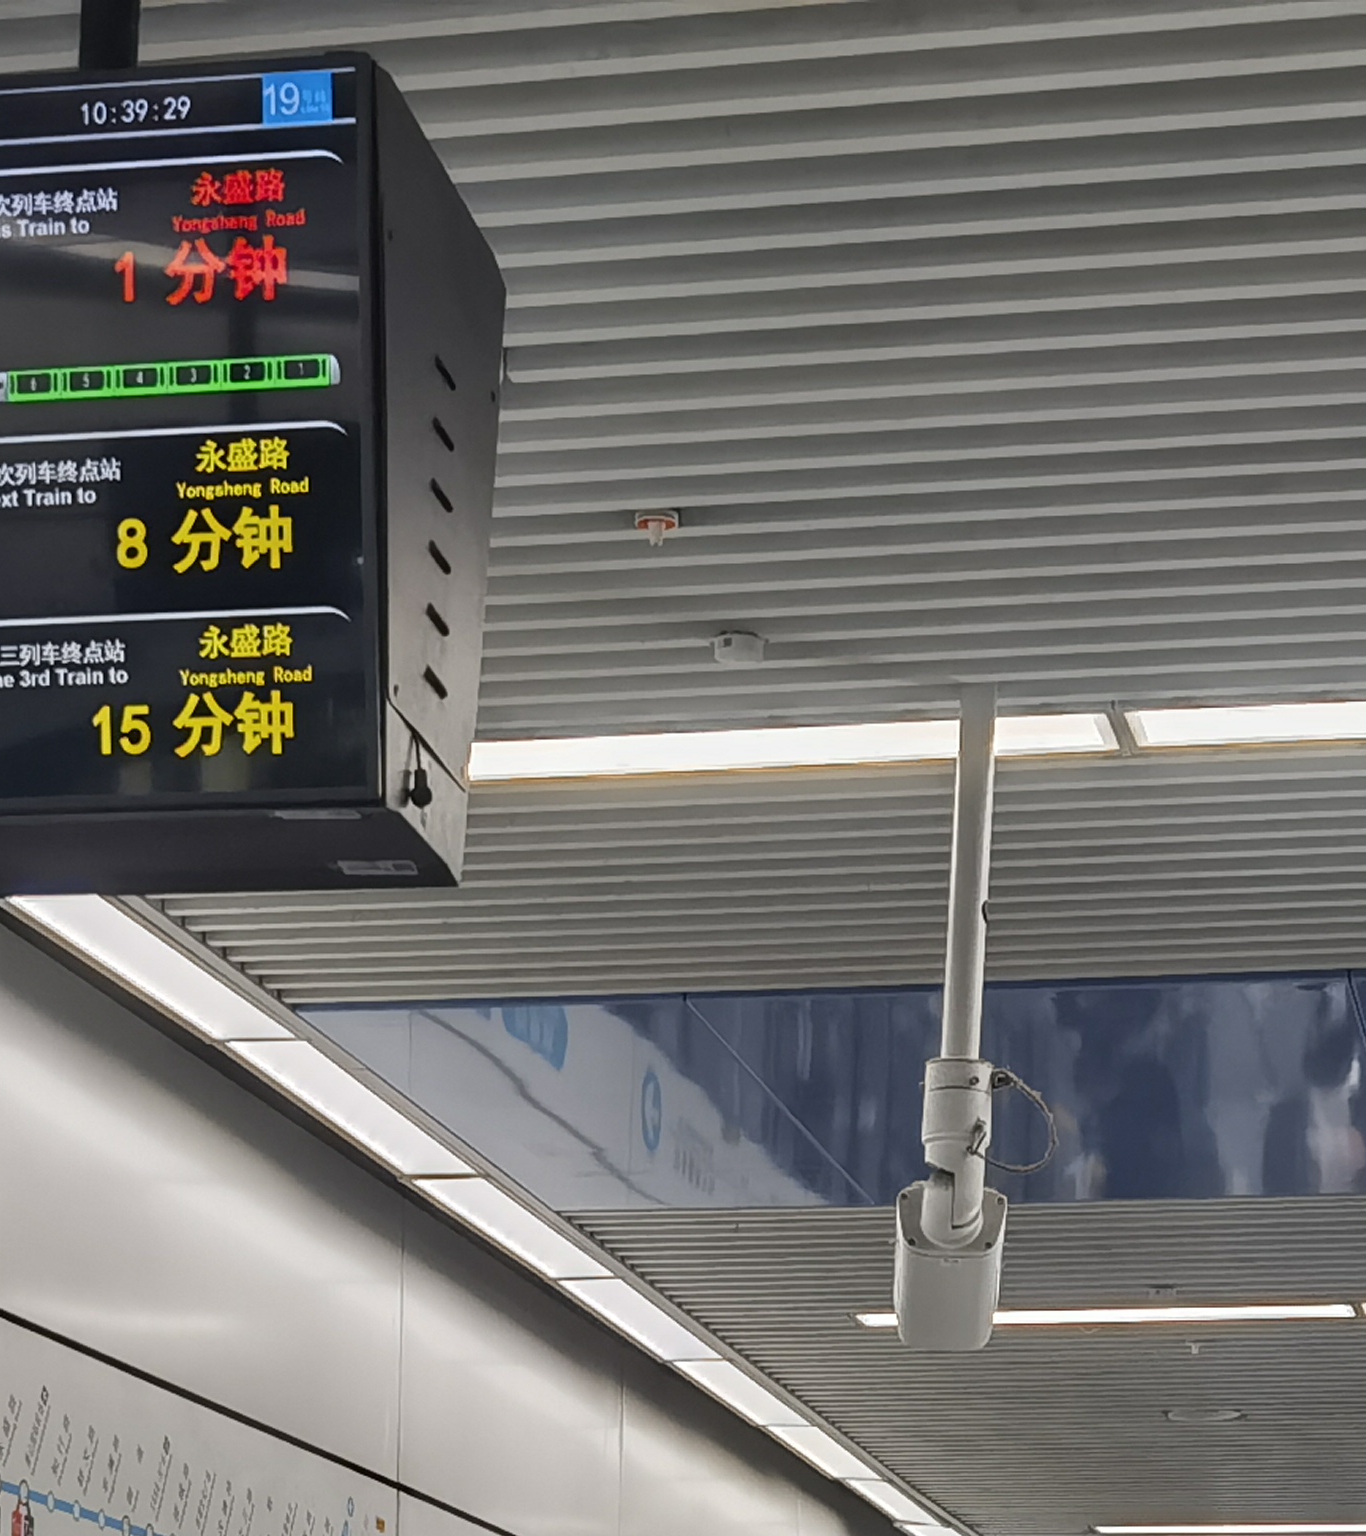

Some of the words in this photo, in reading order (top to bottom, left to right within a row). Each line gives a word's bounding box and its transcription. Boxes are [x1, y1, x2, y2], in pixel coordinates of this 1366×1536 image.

[79, 95, 192, 127] 10:39:29
[191, 167, 285, 207] 永盛路
[17, 218, 66, 238] Train
[70, 217, 91, 236] to
[266, 208, 306, 229] Road
[114, 251, 136, 303] 1
[165, 235, 288, 305] 分钟
[194, 436, 289, 473] 永盛路
[23, 488, 72, 508] Train
[76, 487, 97, 505] to
[176, 480, 262, 500] Yongsheng
[269, 478, 310, 496] Road
[116, 518, 148, 569] 8
[171, 504, 294, 573] 分钟
[198, 623, 294, 660] 永盛路
[19, 669, 51, 688] 3rd
[56, 667, 105, 687] Train
[108, 667, 129, 686] to
[179, 667, 266, 688] Yongsheng
[273, 665, 313, 684] Road
[92, 704, 153, 756] 15
[173, 691, 295, 759] 分钟
